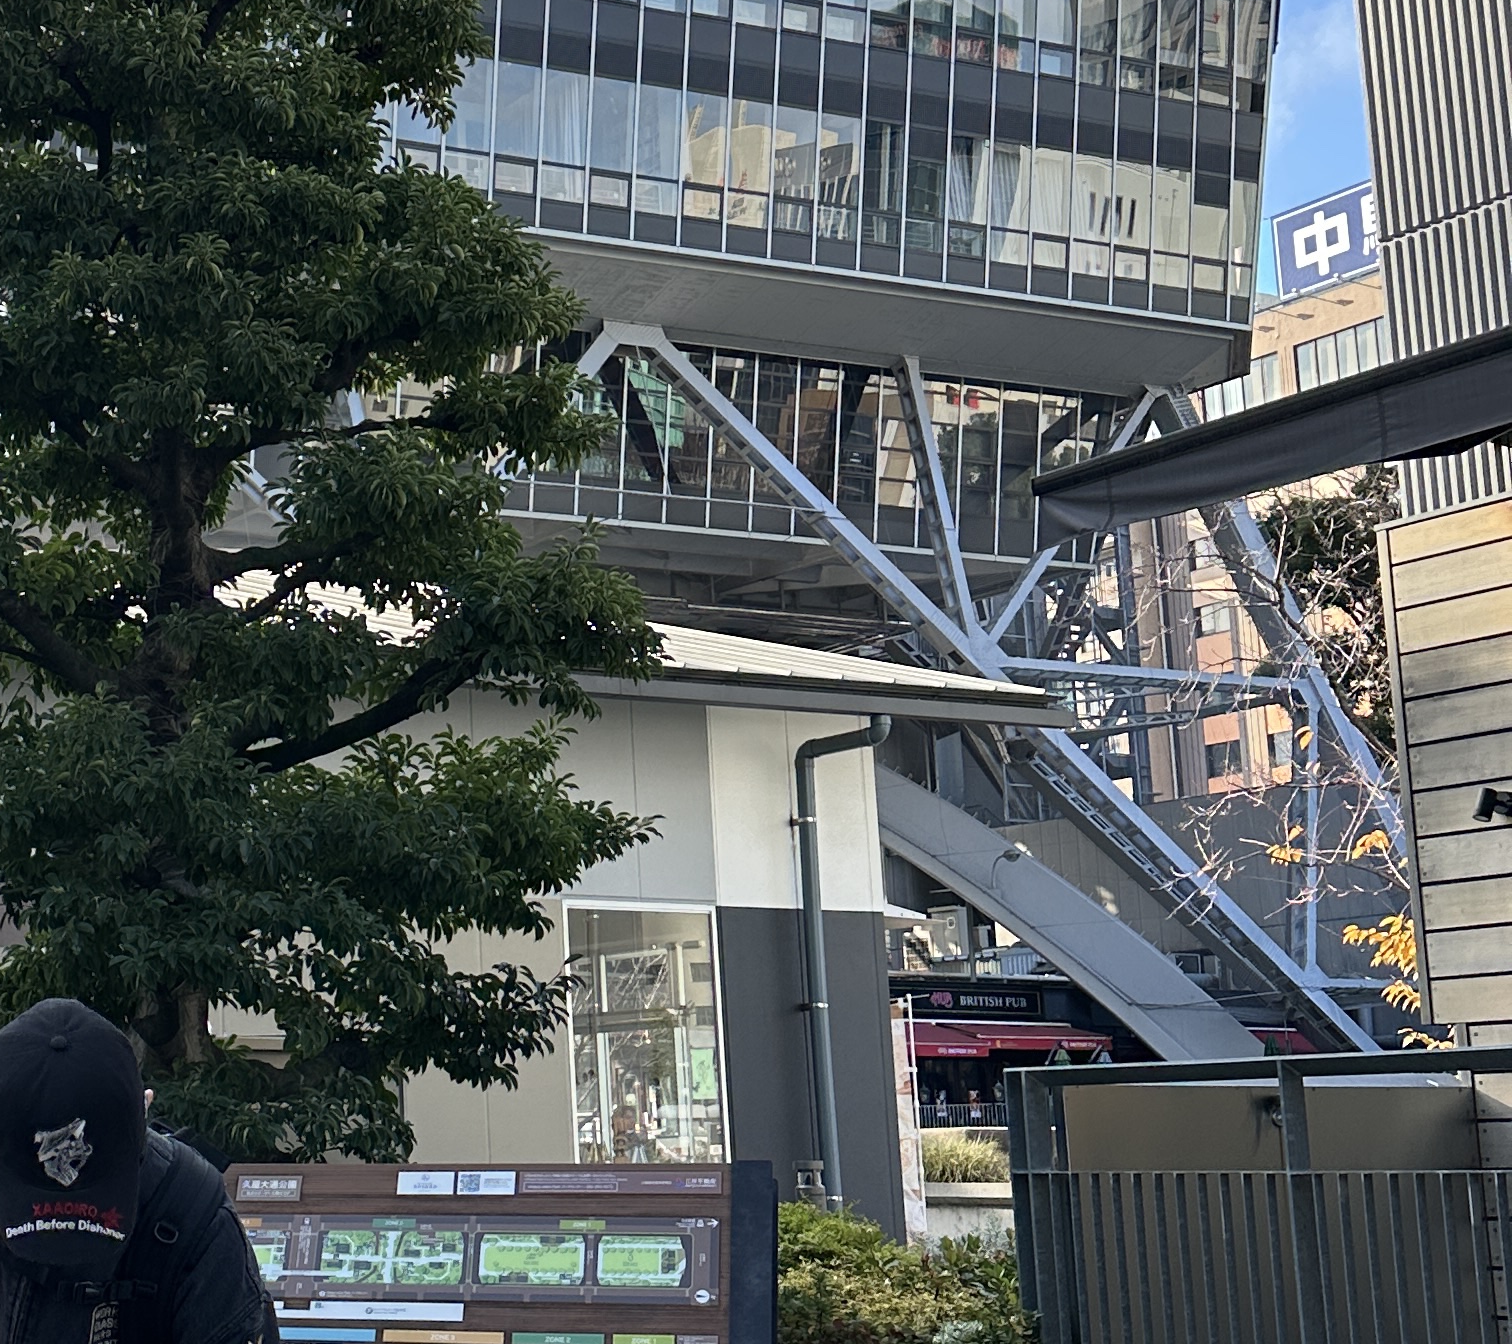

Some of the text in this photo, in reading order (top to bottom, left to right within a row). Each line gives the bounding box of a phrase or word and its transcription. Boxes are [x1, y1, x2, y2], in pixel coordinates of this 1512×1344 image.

[959, 995, 1002, 1008] BRITISH
[1005, 996, 1027, 1009] PUB
[5, 1218, 126, 1241] Death Before Dishonor
